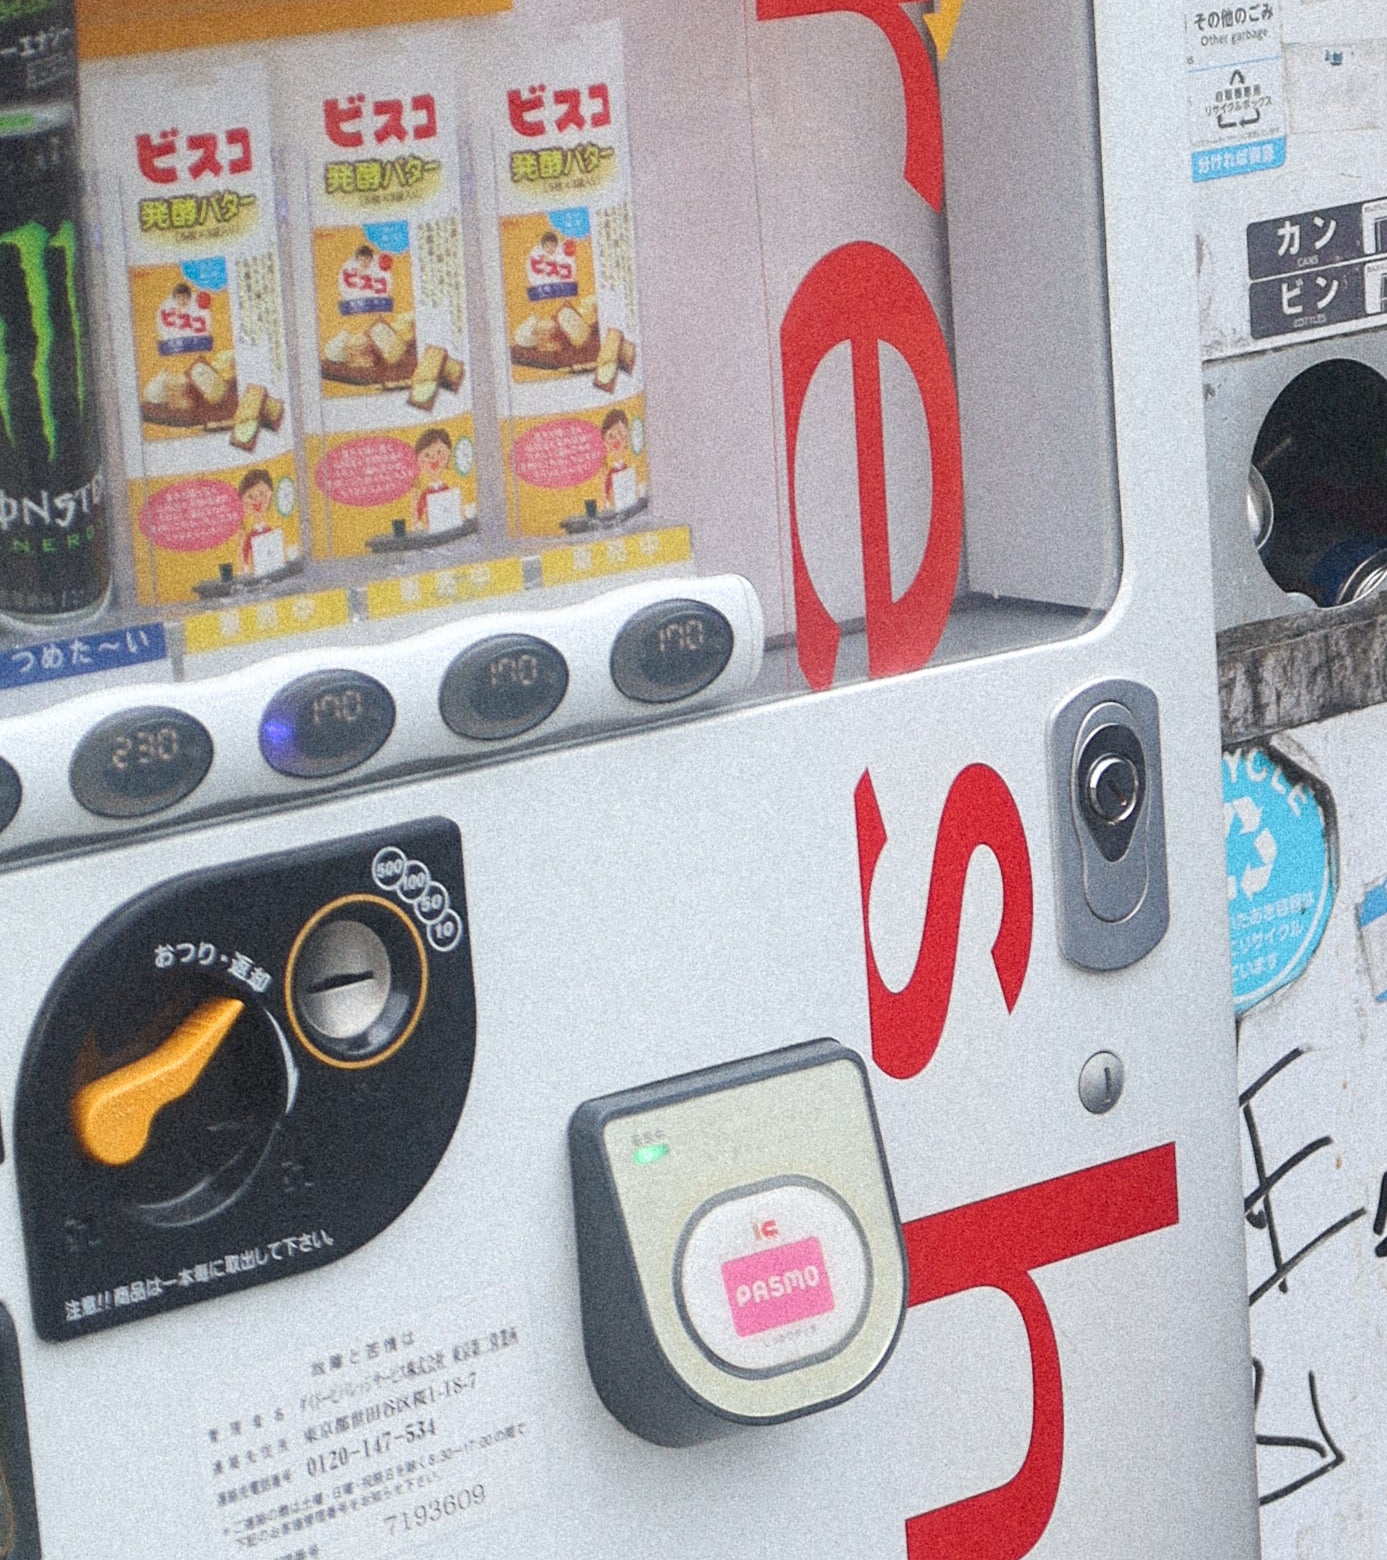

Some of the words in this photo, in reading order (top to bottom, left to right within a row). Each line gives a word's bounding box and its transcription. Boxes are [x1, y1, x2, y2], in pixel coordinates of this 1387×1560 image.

[1193, 2, 1274, 32] その他のごみ
[323, 93, 437, 148] ビスコ
[507, 81, 612, 138] ビスコ
[136, 126, 253, 184] ビスコ
[325, 155, 442, 194] 発酵バター
[510, 141, 615, 183] 発酵バター
[139, 192, 257, 232] 発酵バター
[1276, 216, 1338, 257] カン
[1281, 276, 1340, 316] ビン
[377, 856, 402, 879] 500
[401, 869, 425, 891] 100
[421, 892, 441, 911] 50
[435, 920, 454, 940] 10
[735, 1264, 821, 1309] PASMO
[383, 1483, 487, 1536] 7193609
